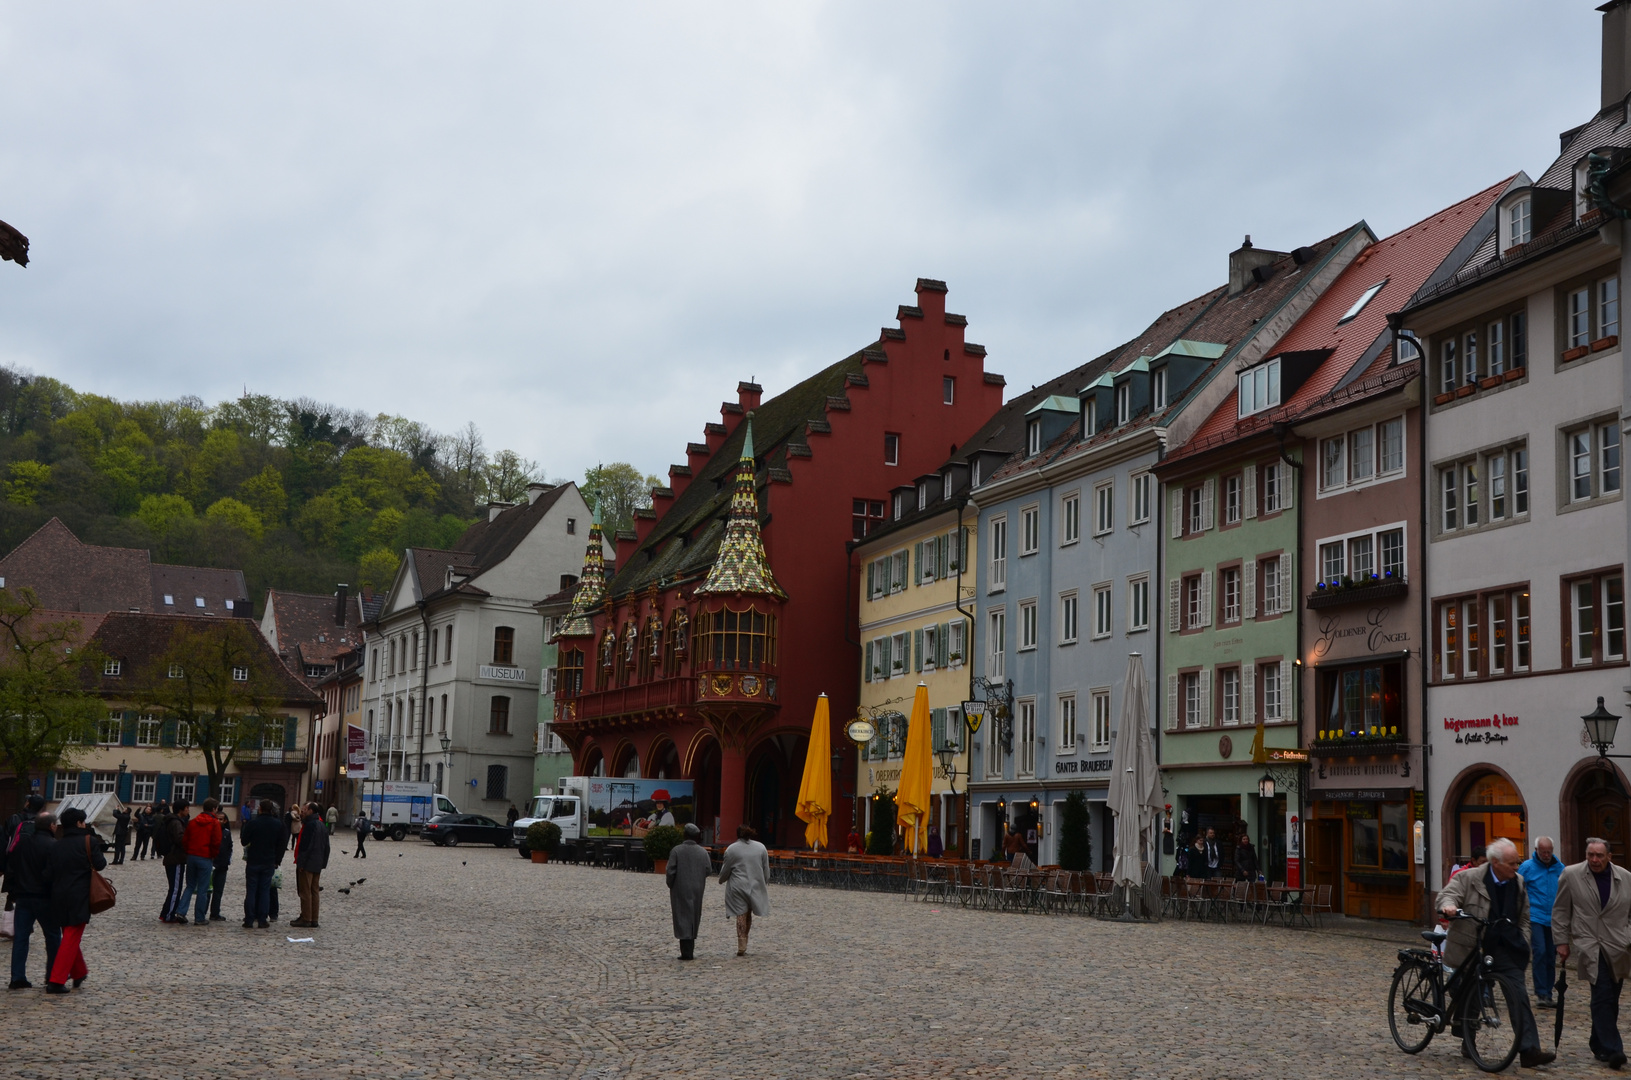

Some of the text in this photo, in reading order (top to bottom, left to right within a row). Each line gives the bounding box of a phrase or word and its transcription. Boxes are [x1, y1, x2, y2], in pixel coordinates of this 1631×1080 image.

[481, 666, 524, 680] MUSEUM
[1444, 713, 1519, 733] högermann & kox
[1455, 733, 1463, 744] die
[1056, 759, 1114, 774] GANTER BRAUEREIA
[1330, 764, 1398, 776] BADISCHES WIRTSHAUS
